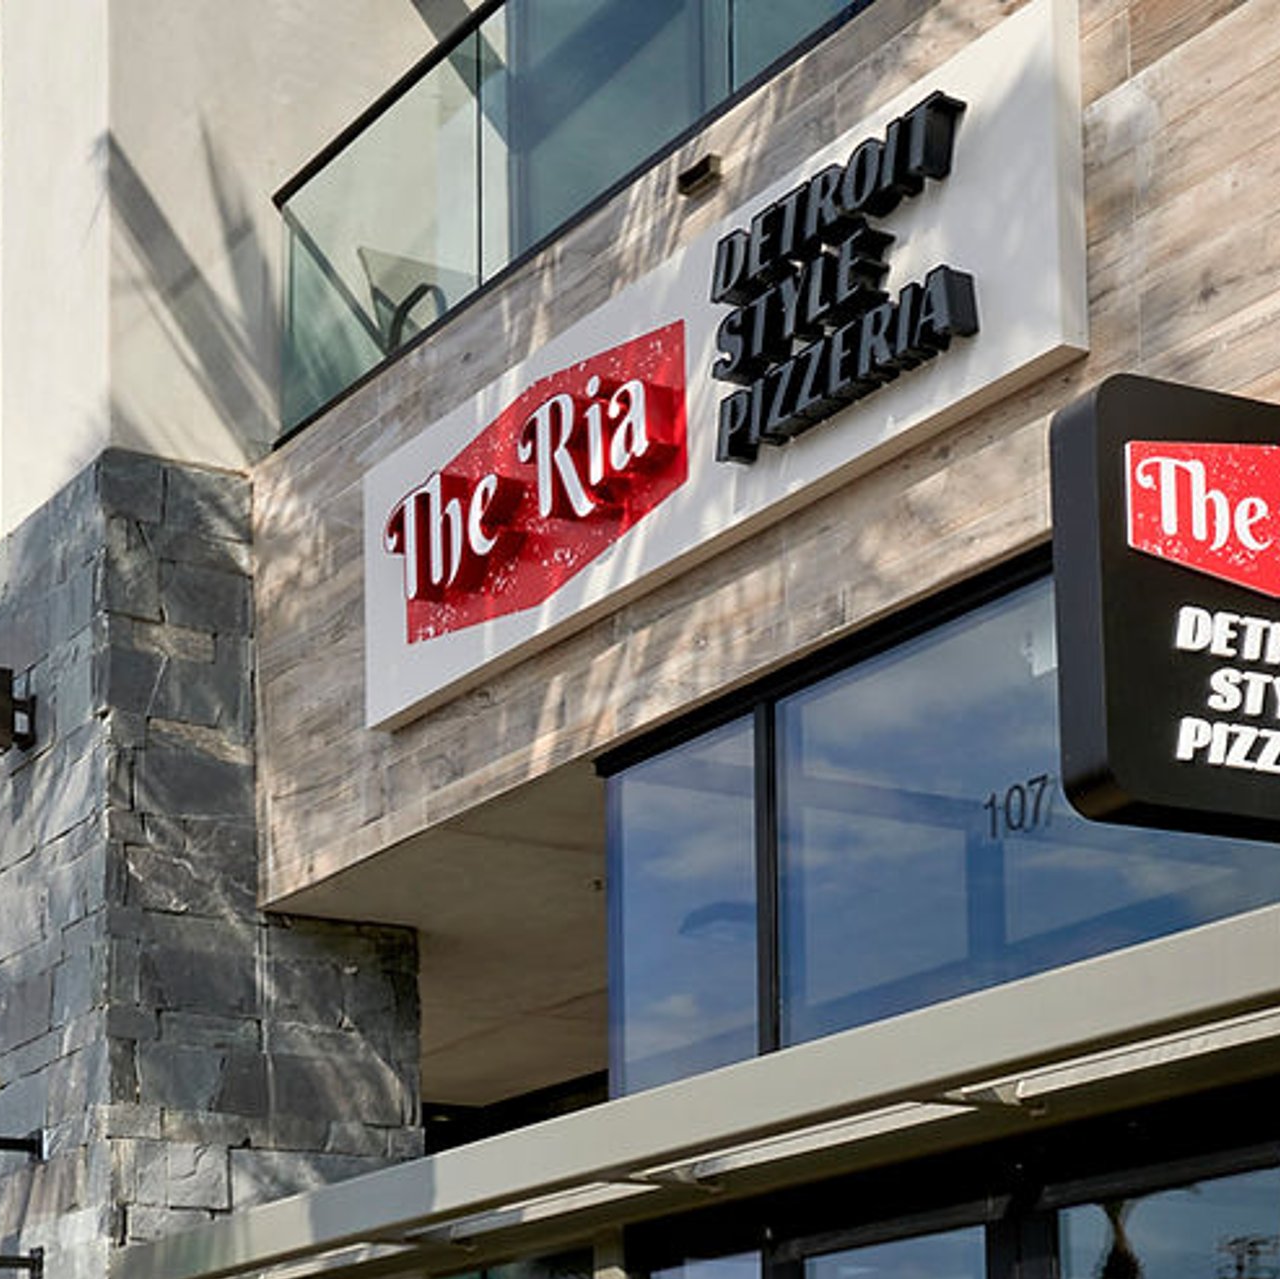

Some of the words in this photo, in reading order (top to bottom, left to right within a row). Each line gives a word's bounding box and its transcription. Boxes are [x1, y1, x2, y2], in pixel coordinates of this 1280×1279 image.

[711, 90, 965, 302] DETROIT
[712, 220, 892, 382] STYLE
[716, 265, 976, 463] PIZZERIA
[384, 472, 498, 600] The
[519, 376, 650, 519] Ria
[1135, 456, 1272, 553] The
[983, 772, 1048, 839] 107
